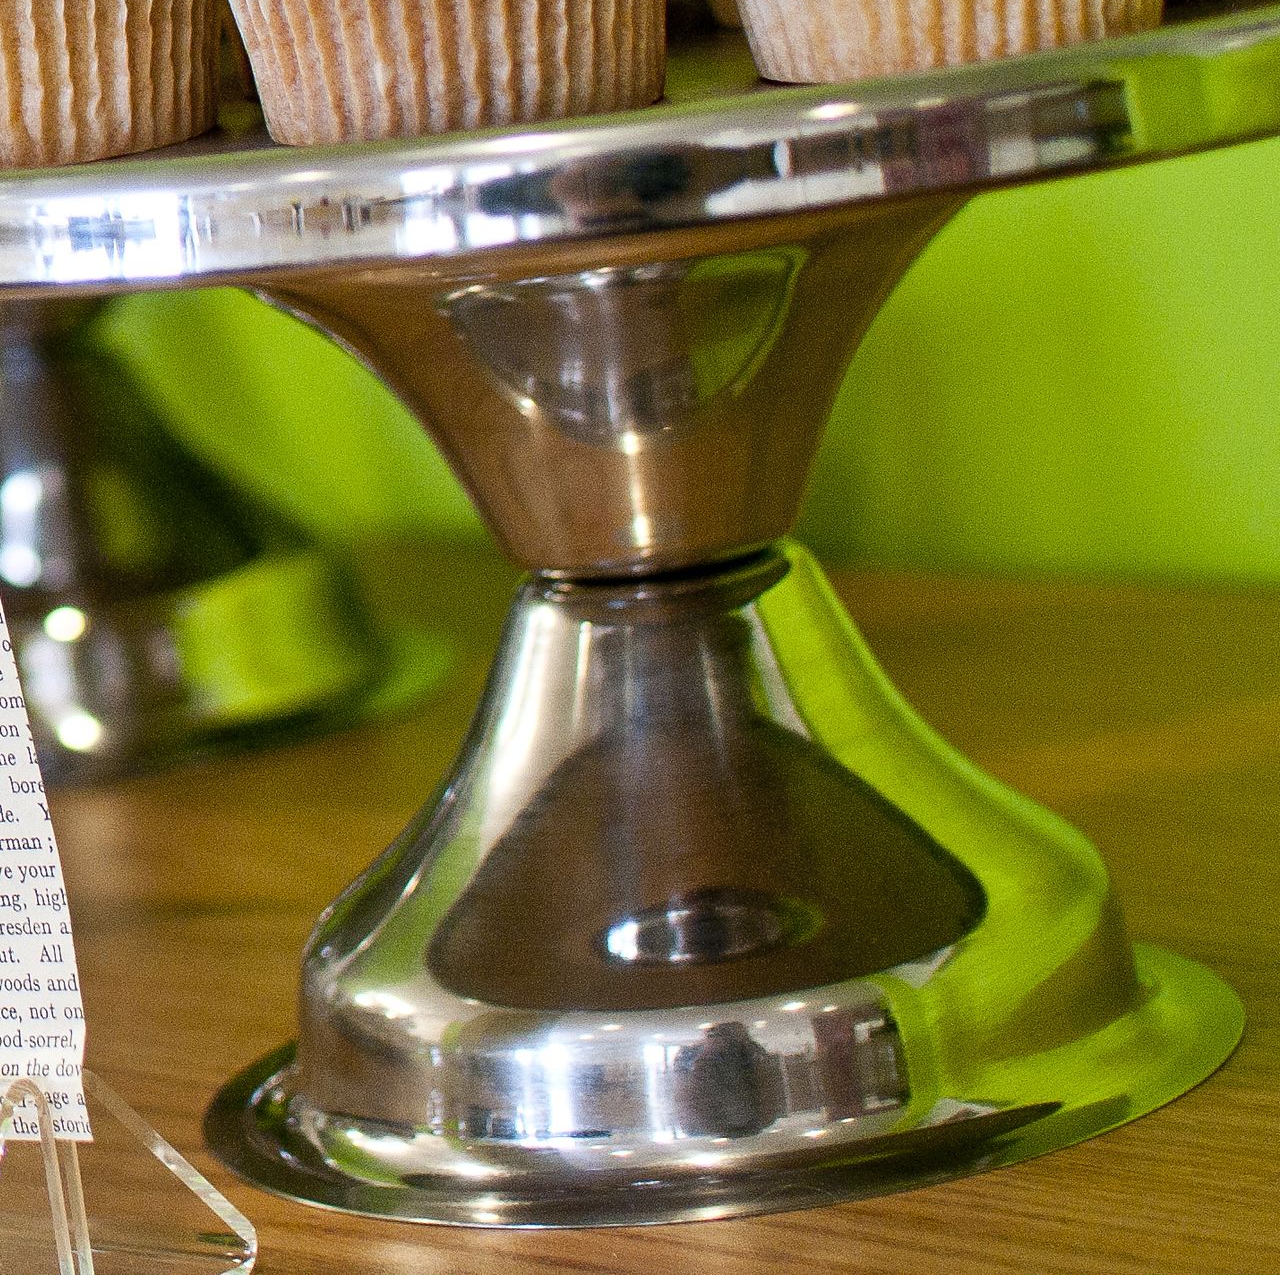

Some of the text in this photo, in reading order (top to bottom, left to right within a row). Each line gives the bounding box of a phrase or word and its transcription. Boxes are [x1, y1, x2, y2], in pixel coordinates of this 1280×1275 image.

[0, 723, 20, 738] on
[18, 864, 56, 884] your
[40, 944, 64, 963] All
[47, 973, 78, 992] and
[29, 1005, 56, 1020] not
[1, 1062, 19, 1076] on
[26, 1058, 50, 1077] the
[12, 1116, 39, 1134] the
